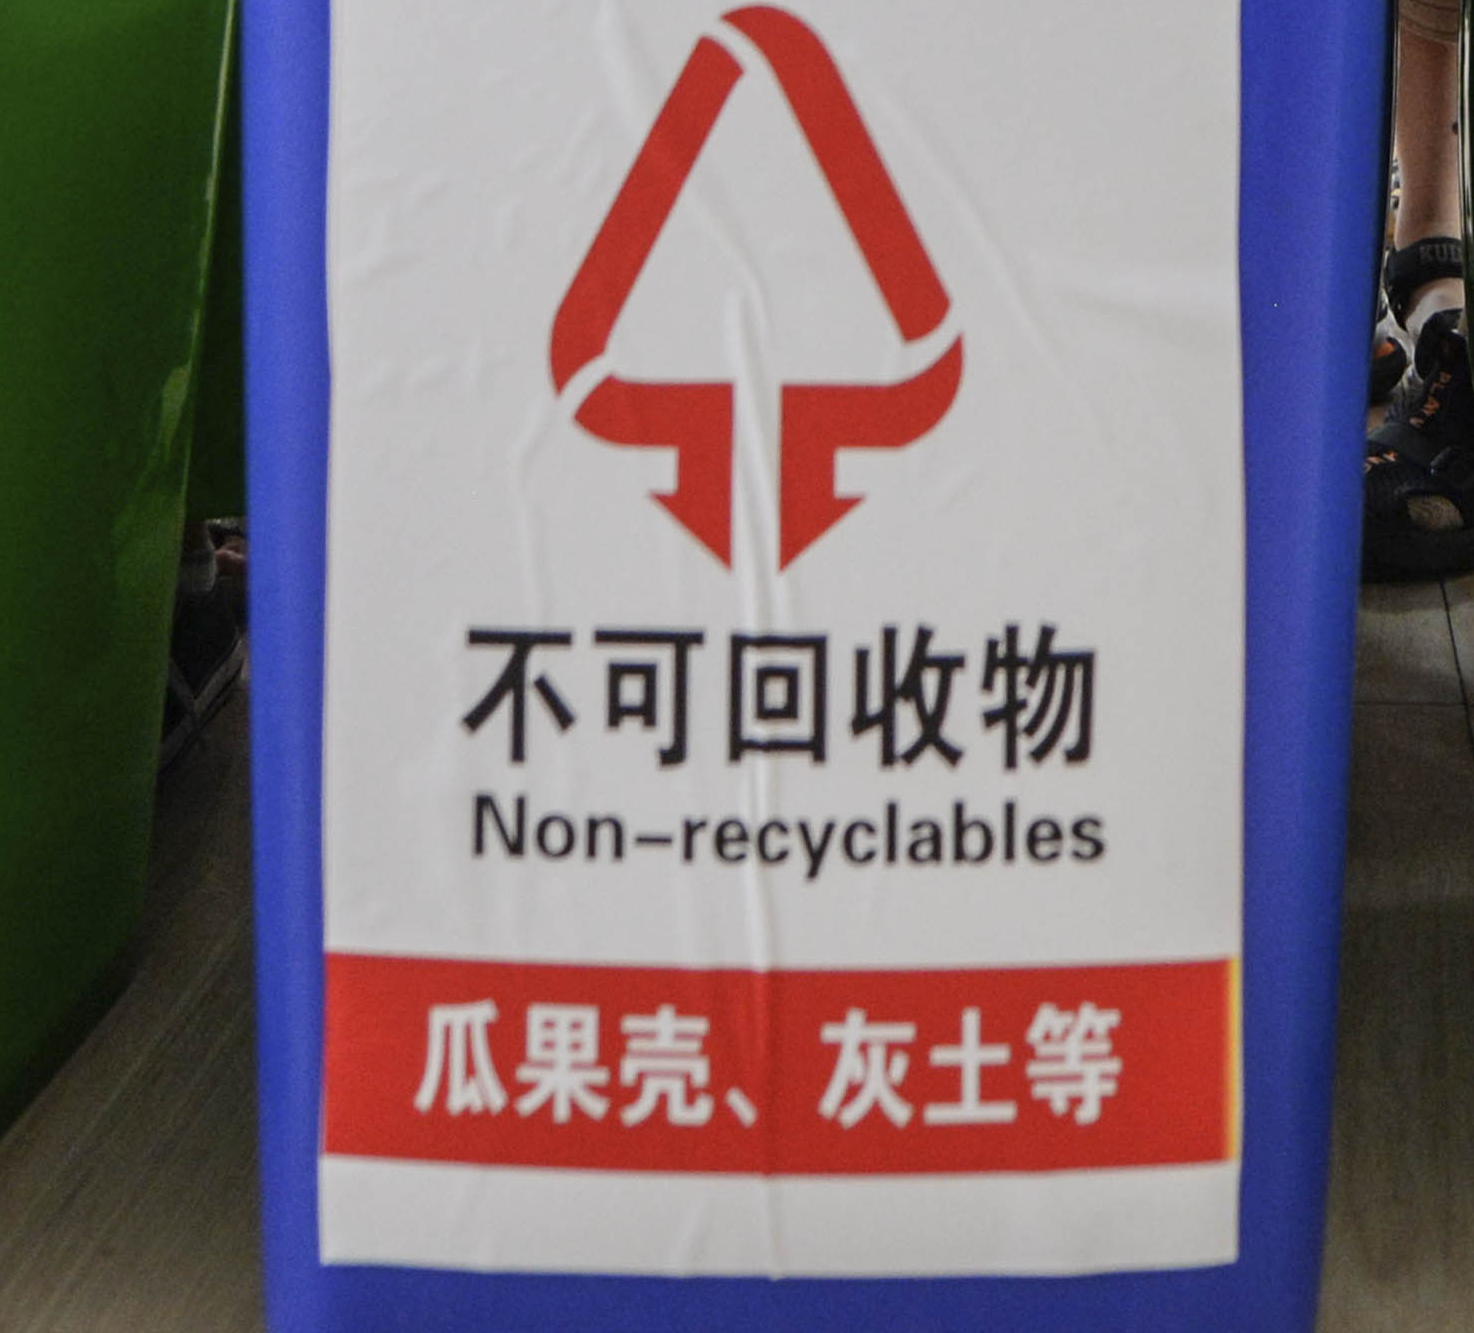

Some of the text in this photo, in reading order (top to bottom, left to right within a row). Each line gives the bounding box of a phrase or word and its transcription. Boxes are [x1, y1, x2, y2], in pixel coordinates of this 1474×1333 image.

[461, 623, 1096, 771] 不可回收物
[471, 791, 1107, 882] Non-recyclables
[413, 999, 1123, 1128] 瓜果壳、灰土等
